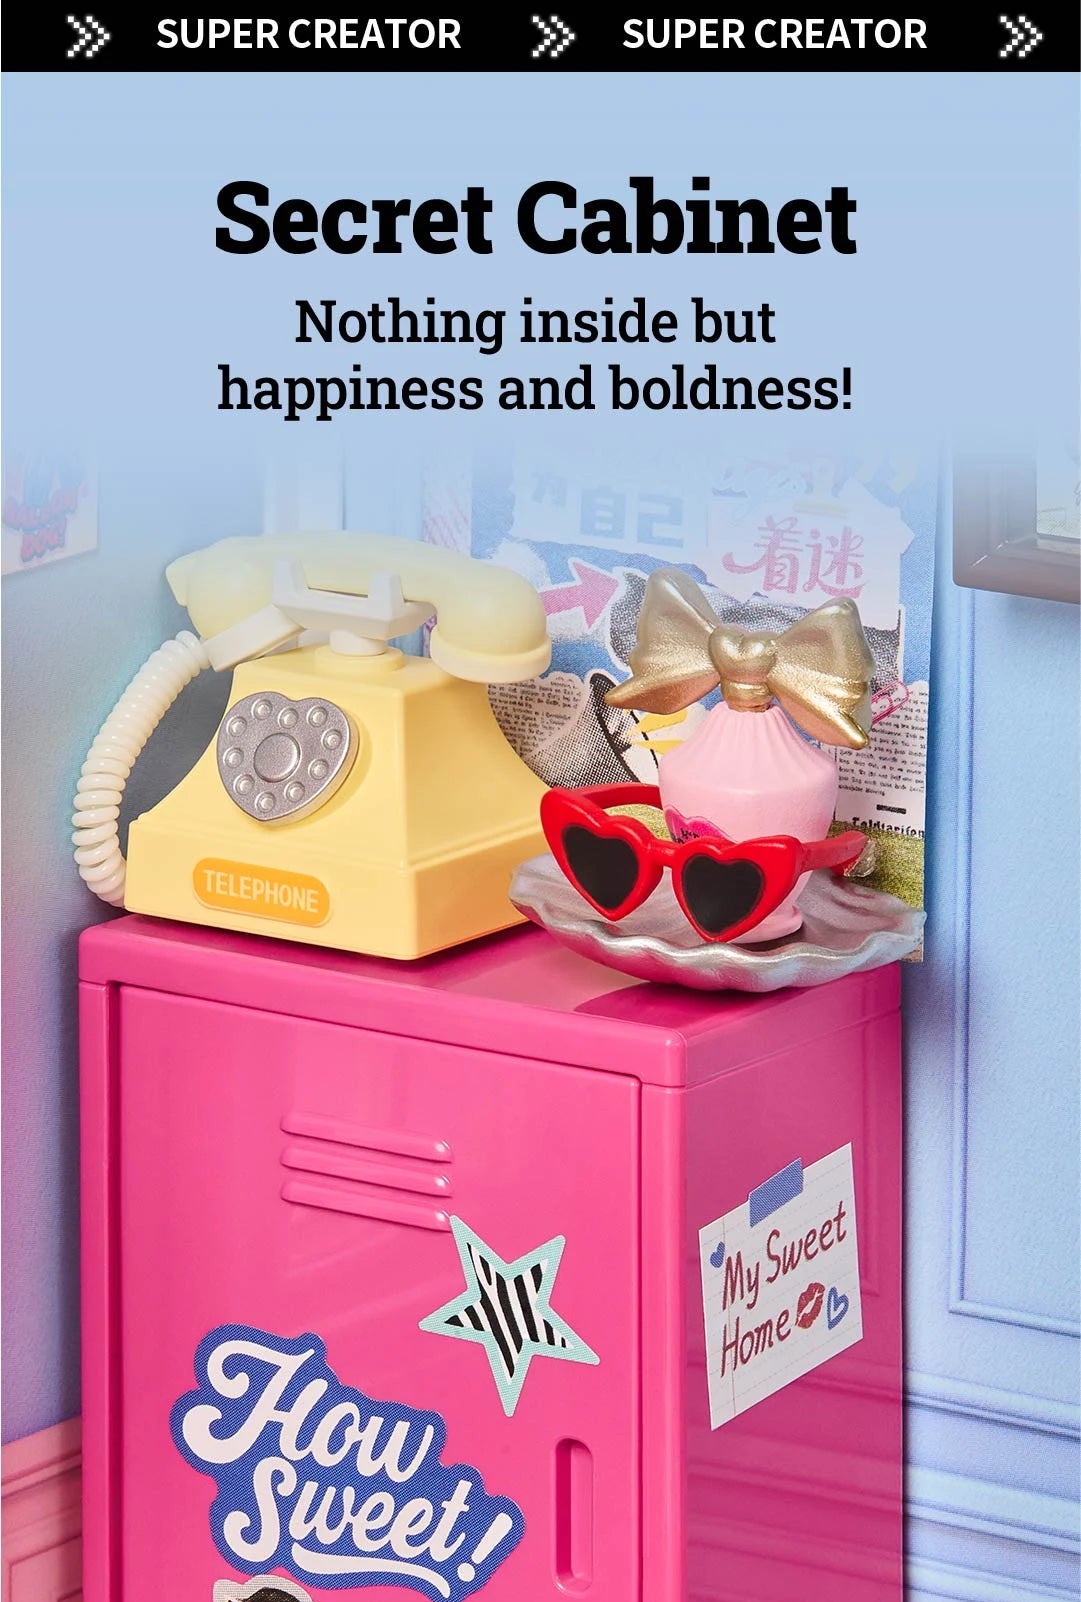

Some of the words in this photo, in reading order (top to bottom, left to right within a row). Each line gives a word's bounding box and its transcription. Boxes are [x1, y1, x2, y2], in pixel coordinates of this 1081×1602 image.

[721, 514, 868, 599] 着迷
[202, 868, 320, 914] TELEPHONE
[722, 1250, 760, 1310] My
[765, 1200, 848, 1284] Sweet
[720, 1307, 792, 1378] Home
[182, 1339, 435, 1484] How
[222, 1456, 513, 1584] Sweet!
